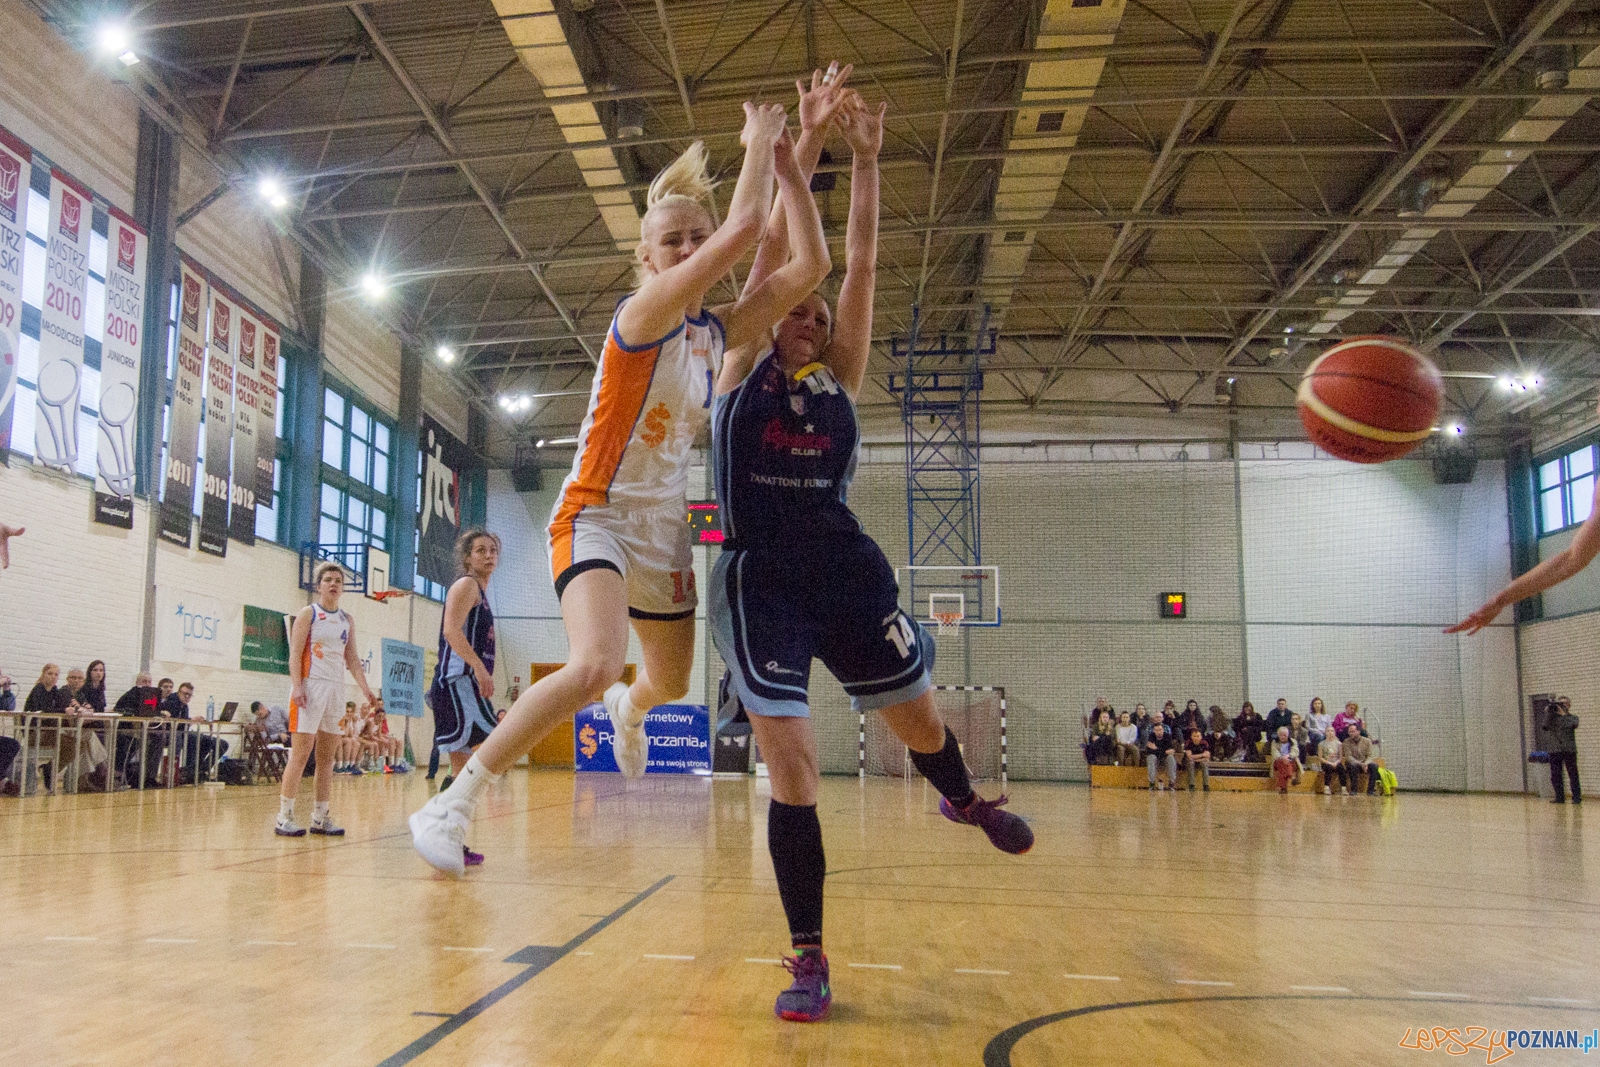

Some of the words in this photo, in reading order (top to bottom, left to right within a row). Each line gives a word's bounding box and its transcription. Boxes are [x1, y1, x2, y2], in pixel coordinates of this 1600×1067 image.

[49, 235, 86, 272] MISTRZ
[47, 256, 85, 293] POLSKI
[109, 269, 141, 301] MISTRZ
[46, 281, 81, 321] 2010
[108, 289, 140, 320] POLSKI
[107, 312, 137, 347] 2010
[107, 349, 136, 370] JUNIOREK
[166, 456, 191, 488] 2011
[203, 471, 228, 501] 2012
[231, 483, 255, 511] 2012
[340, 629, 348, 645] 4
